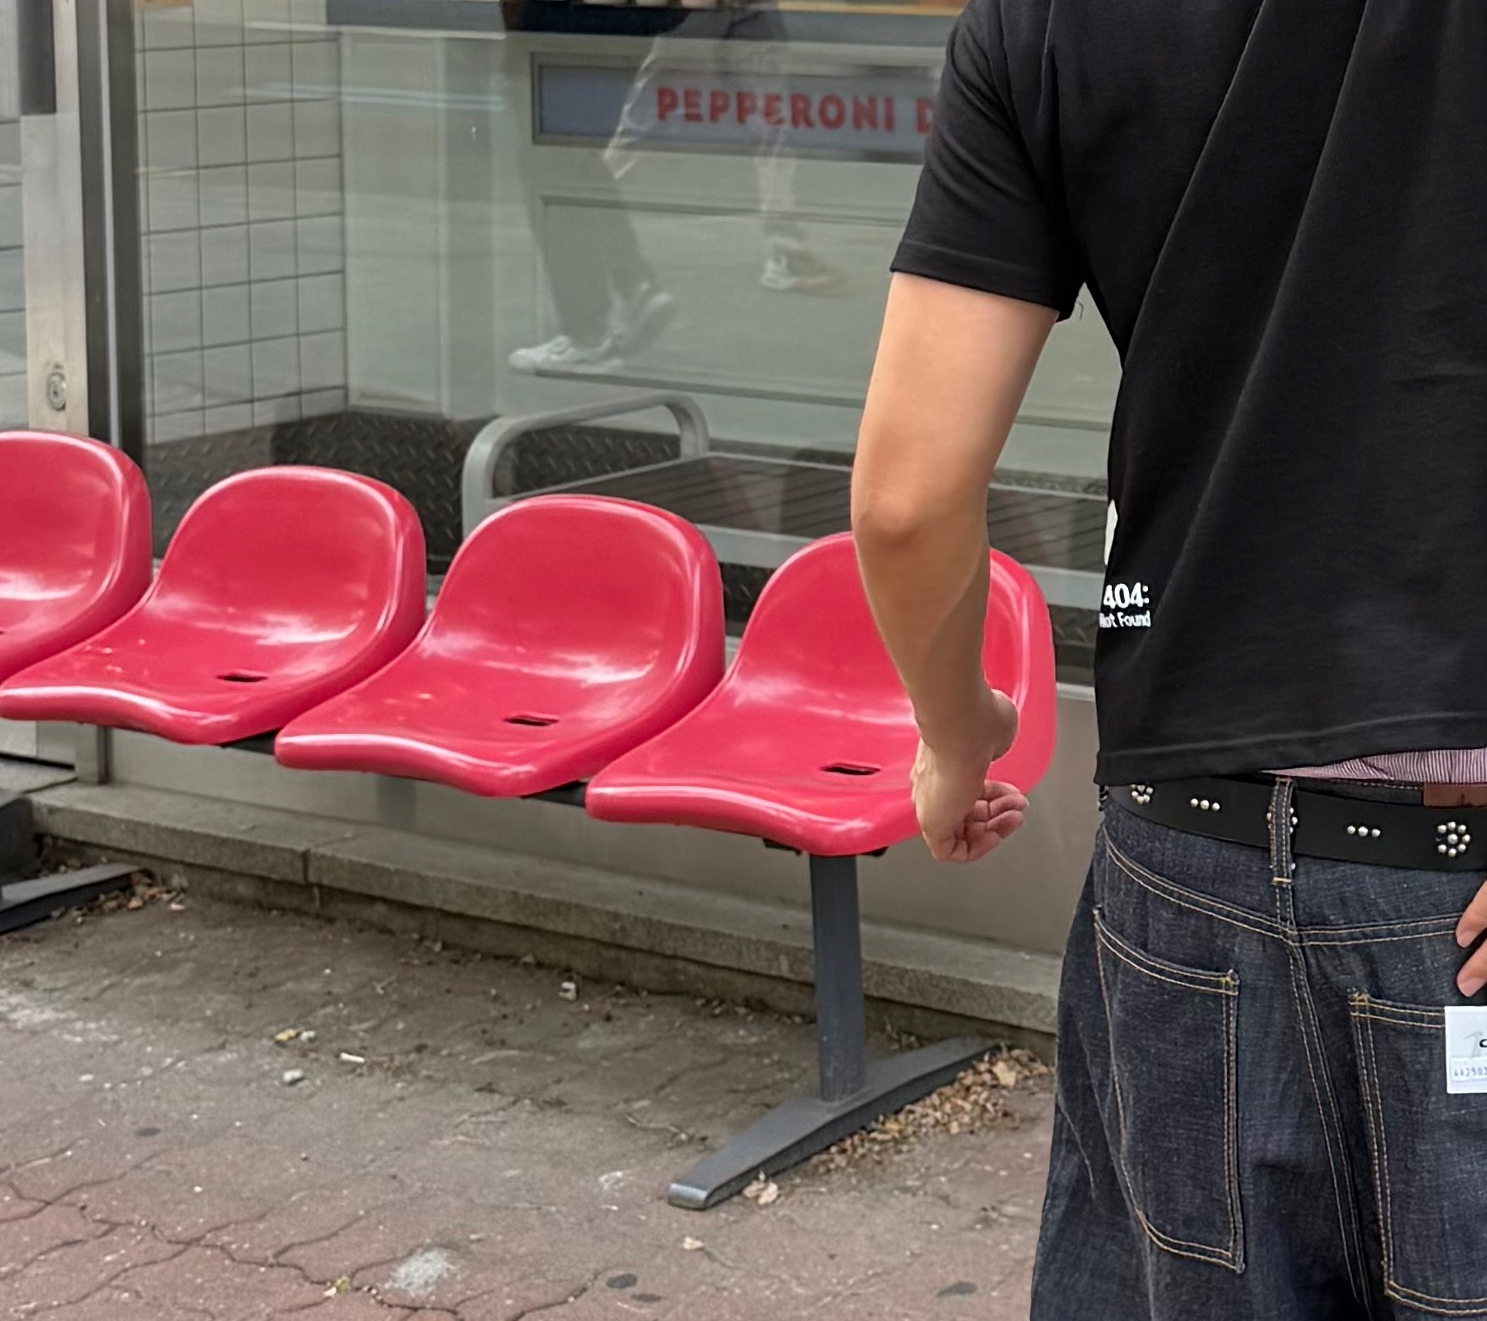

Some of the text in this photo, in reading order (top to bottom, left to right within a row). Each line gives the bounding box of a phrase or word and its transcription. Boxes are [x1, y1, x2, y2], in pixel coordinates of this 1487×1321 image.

[656, 86, 896, 133] PEPPERONI
[1103, 582, 1150, 609] 404:
[1117, 610, 1152, 628] Found
